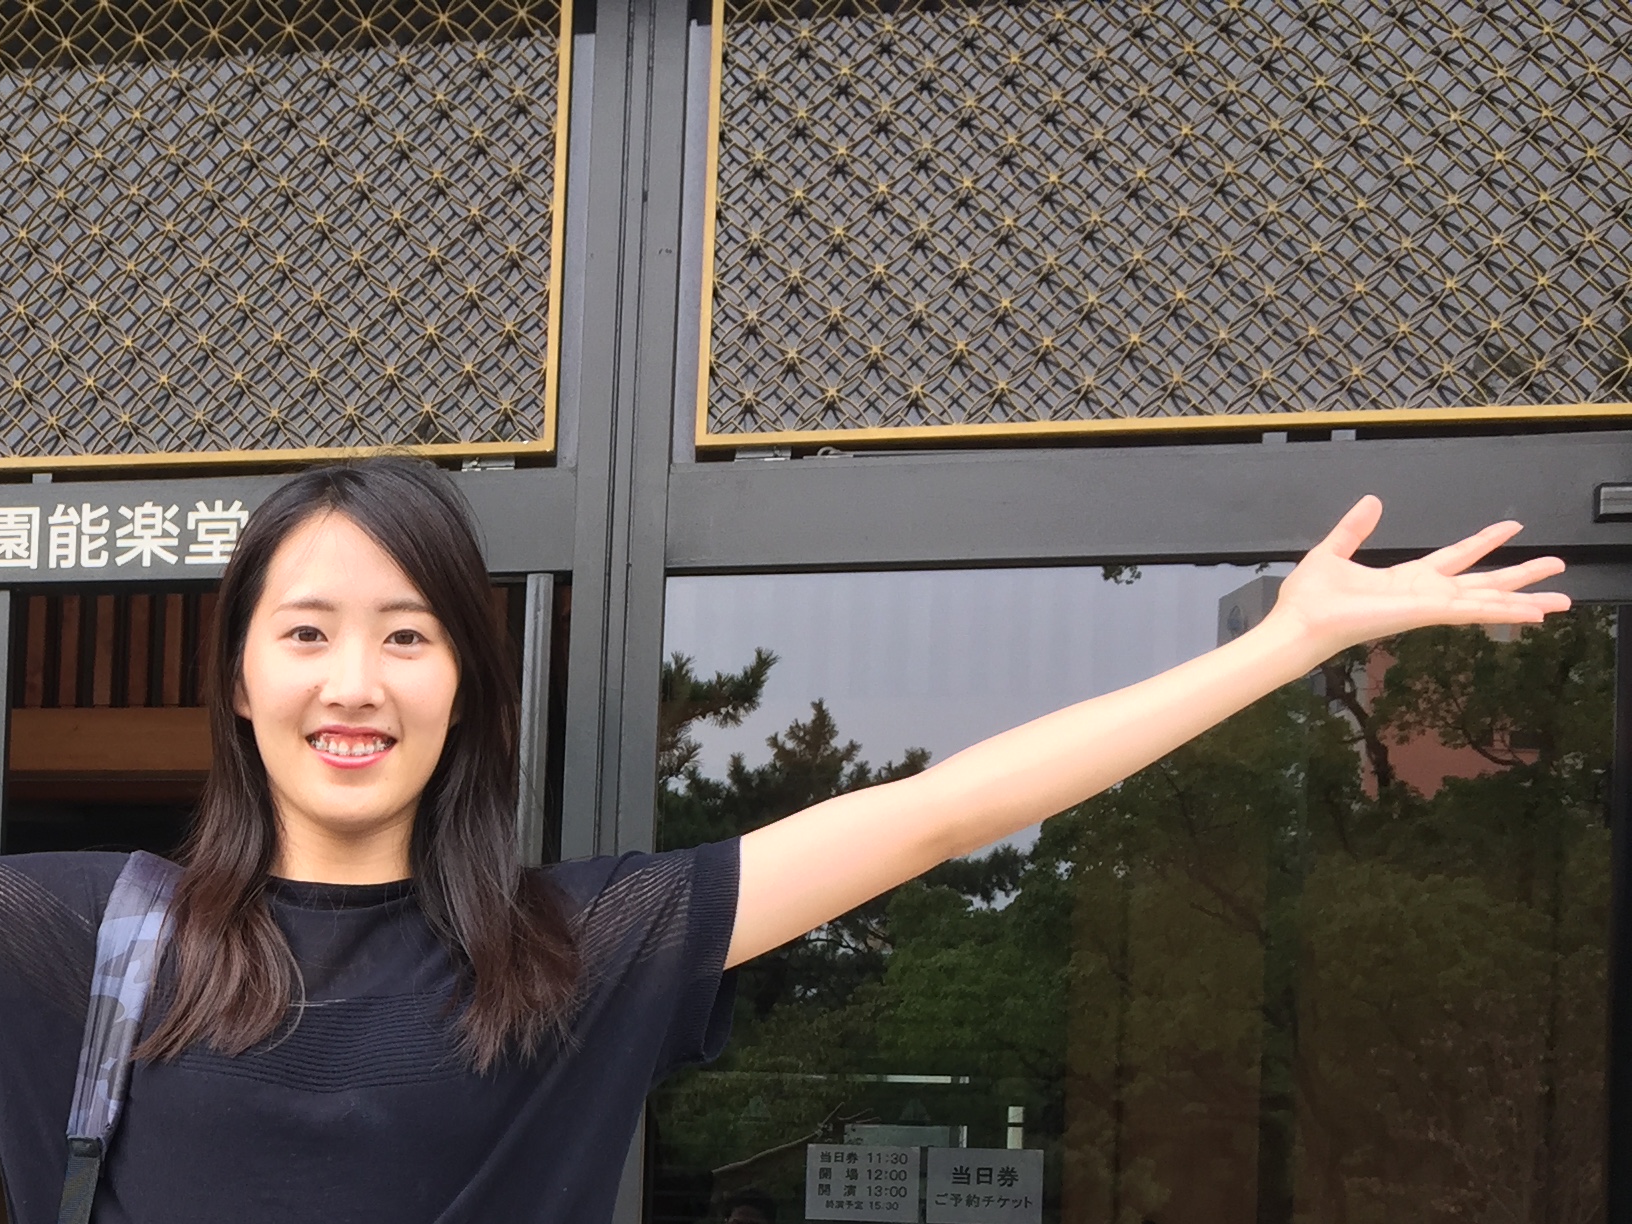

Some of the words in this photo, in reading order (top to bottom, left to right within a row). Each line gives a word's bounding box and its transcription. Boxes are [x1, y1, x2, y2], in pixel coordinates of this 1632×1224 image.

[819, 1150, 859, 1164] 当日券
[867, 1152, 908, 1165] 11:30
[866, 1169, 907, 1181] 12:00
[951, 1165, 1019, 1187] 当日券
[866, 1185, 908, 1198] 13:00
[935, 1192, 1033, 1209] ご予約チケット
